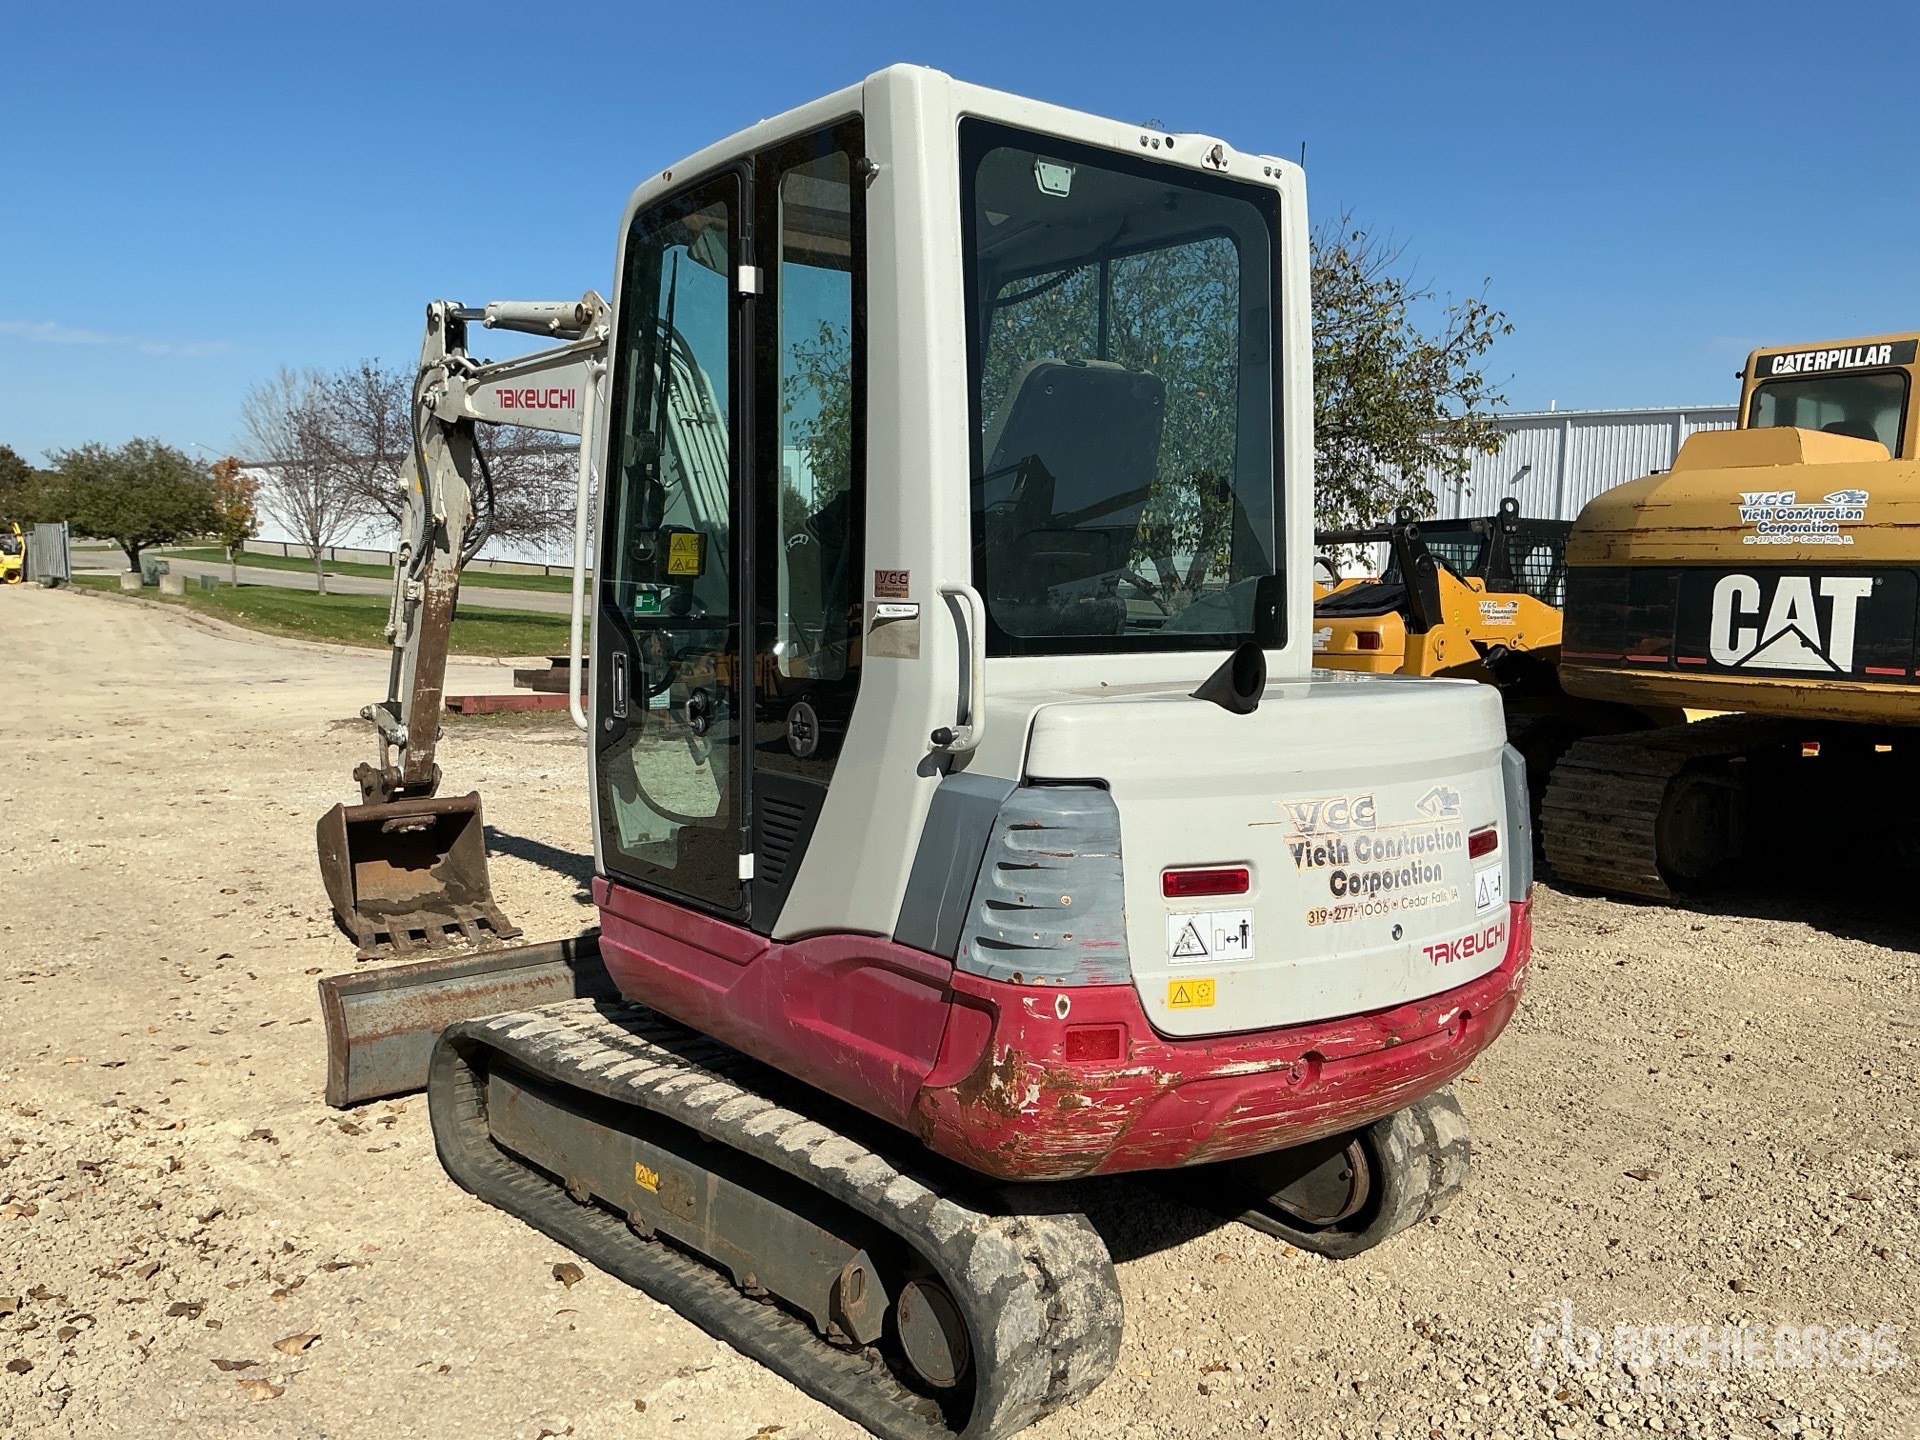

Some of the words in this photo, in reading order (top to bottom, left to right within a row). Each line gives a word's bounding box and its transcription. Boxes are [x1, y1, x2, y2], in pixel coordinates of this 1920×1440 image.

[1771, 345, 1892, 375] CATERPILLAR
[496, 388, 575, 409] TAKEUCHI
[1741, 508, 1772, 520] Vieth
[1776, 507, 1862, 520] Construction
[1745, 491, 1795, 506] VCC
[1758, 520, 1838, 535] Corporation
[880, 571, 908, 585] VCC
[1709, 574, 1874, 673] CAT
[1284, 796, 1377, 832] VCC
[1289, 838, 1350, 868] Vieth
[1354, 826, 1462, 862] Construction
[1329, 859, 1442, 898] Corporation
[1308, 902, 1389, 924] 319-277-1006
[1402, 894, 1428, 909] Cedar
[1423, 923, 1505, 966] TAKEUCHI
